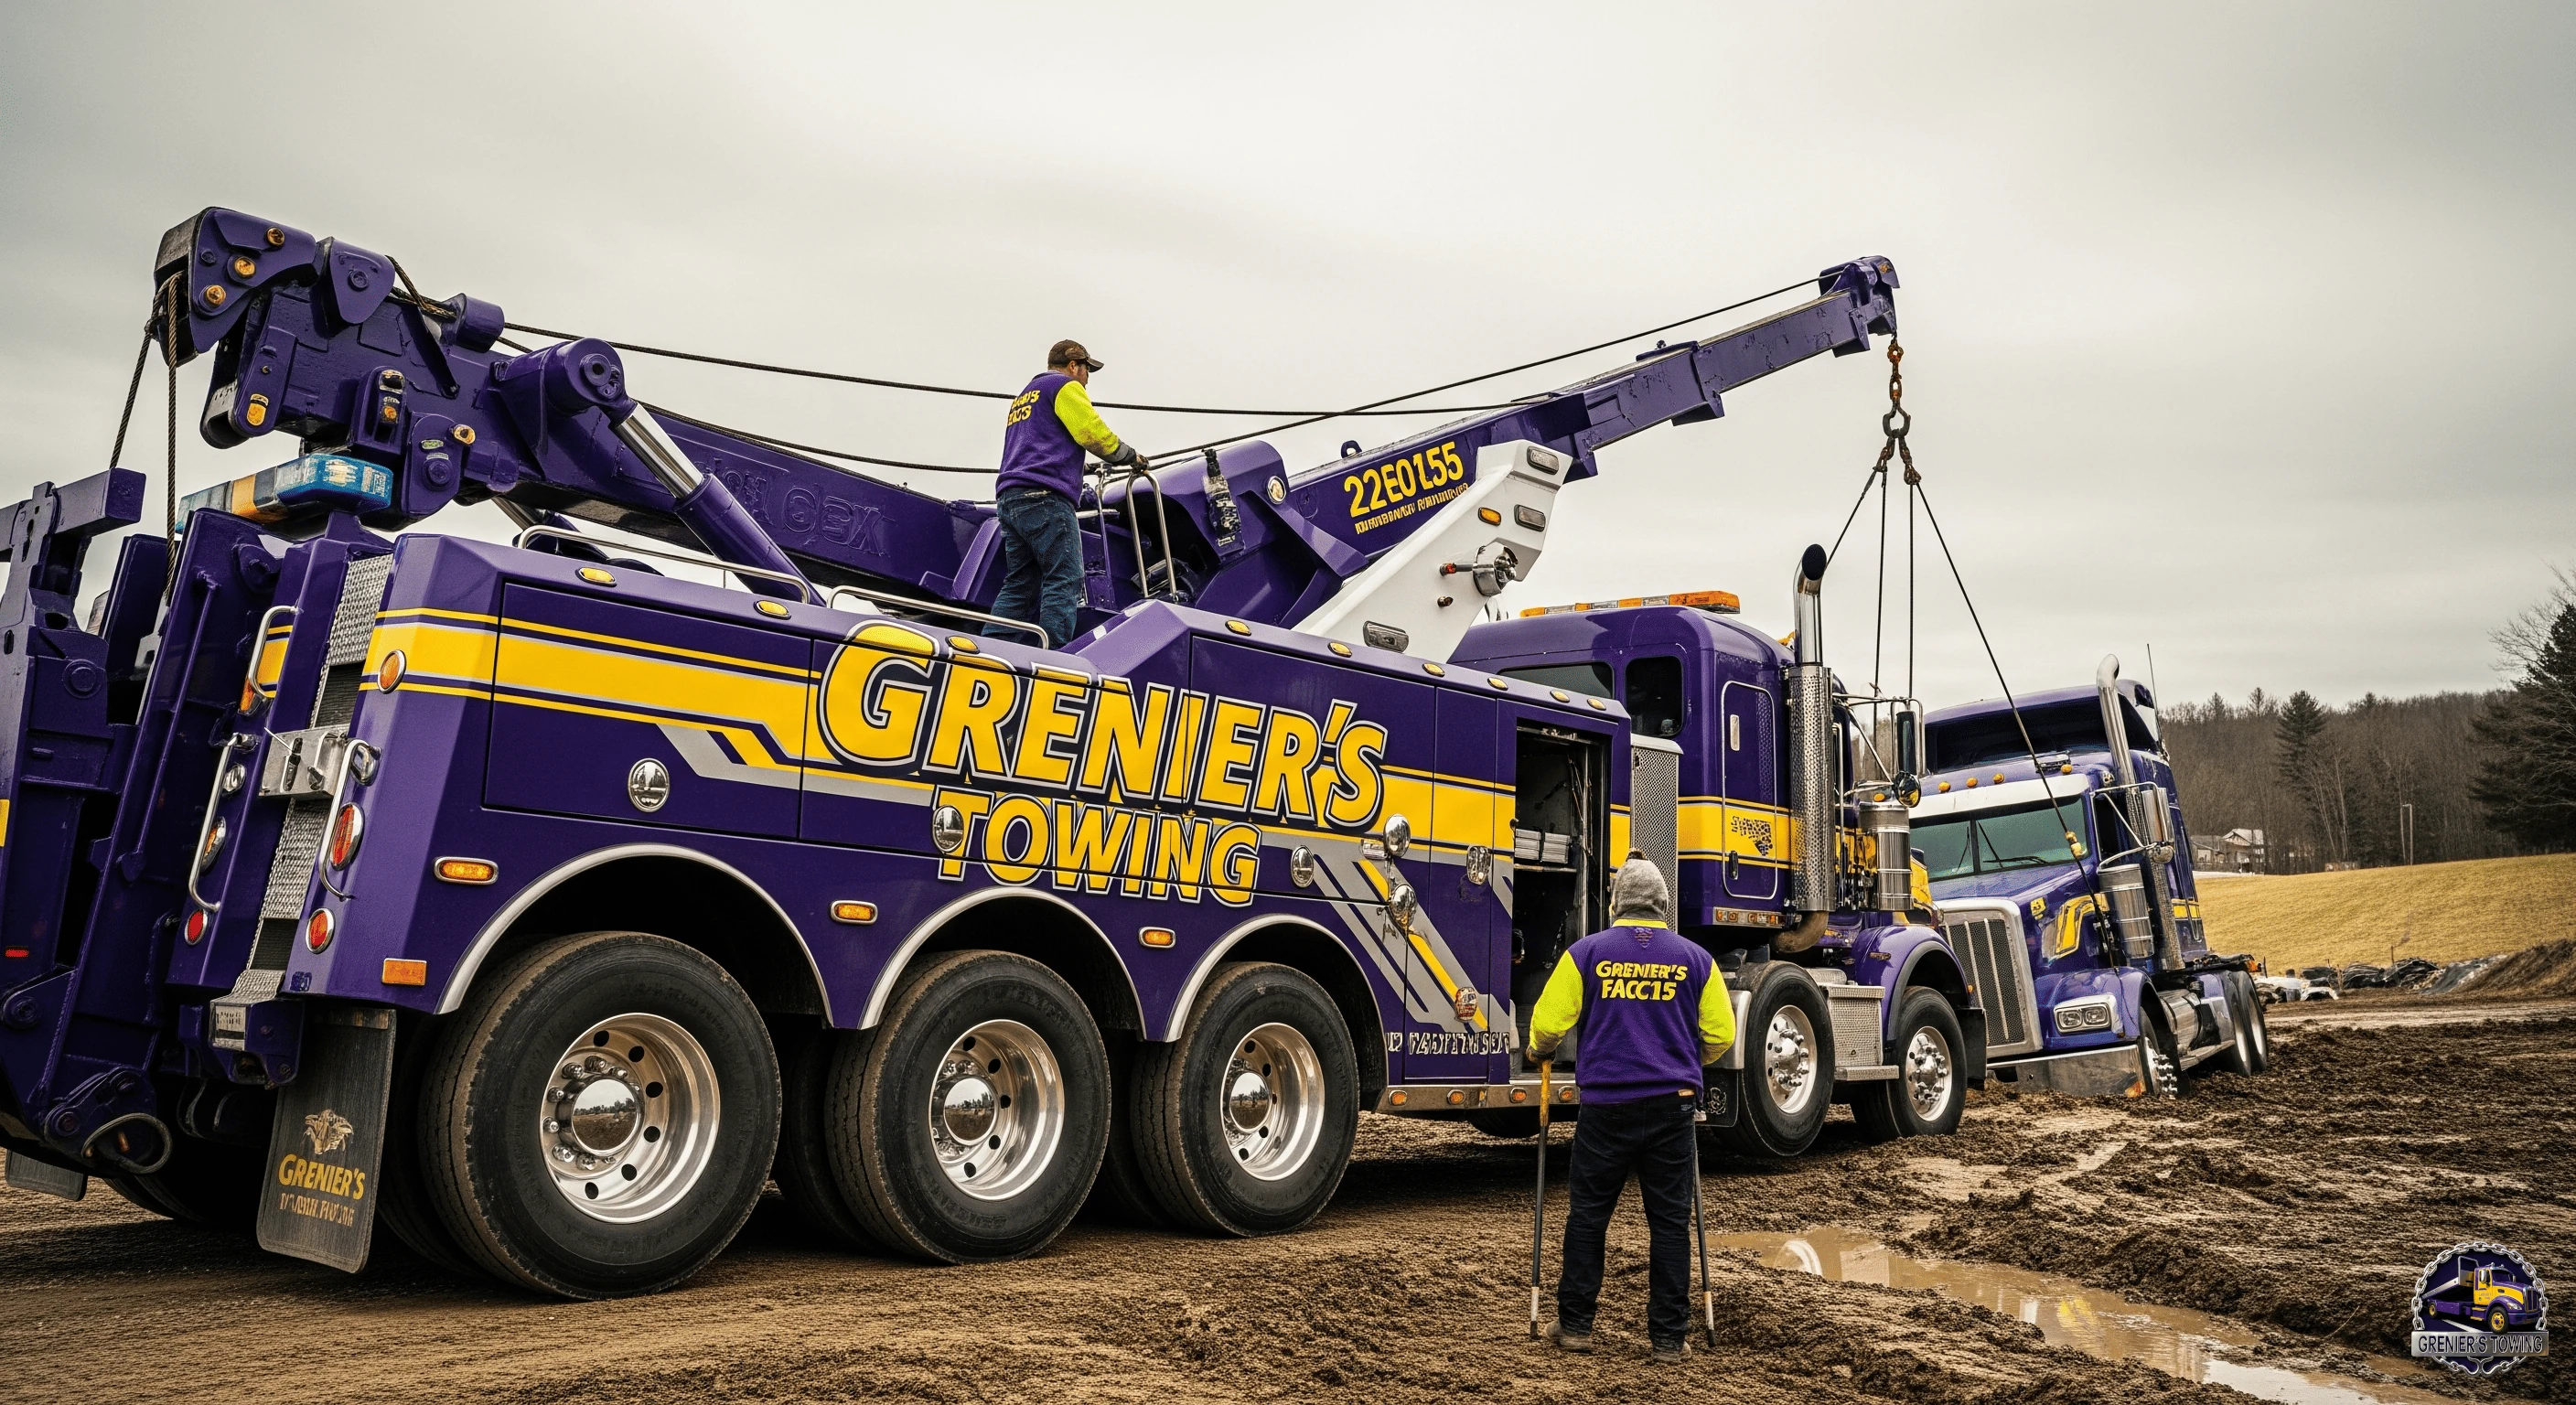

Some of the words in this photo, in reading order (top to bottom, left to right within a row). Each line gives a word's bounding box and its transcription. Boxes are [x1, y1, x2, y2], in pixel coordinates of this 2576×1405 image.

[817, 619, 1388, 828] GRENIER'S
[932, 785, 1261, 906] TOWING
[1595, 960, 1688, 981] GRENIER'S
[278, 1153, 366, 1200] GRENIER'S
